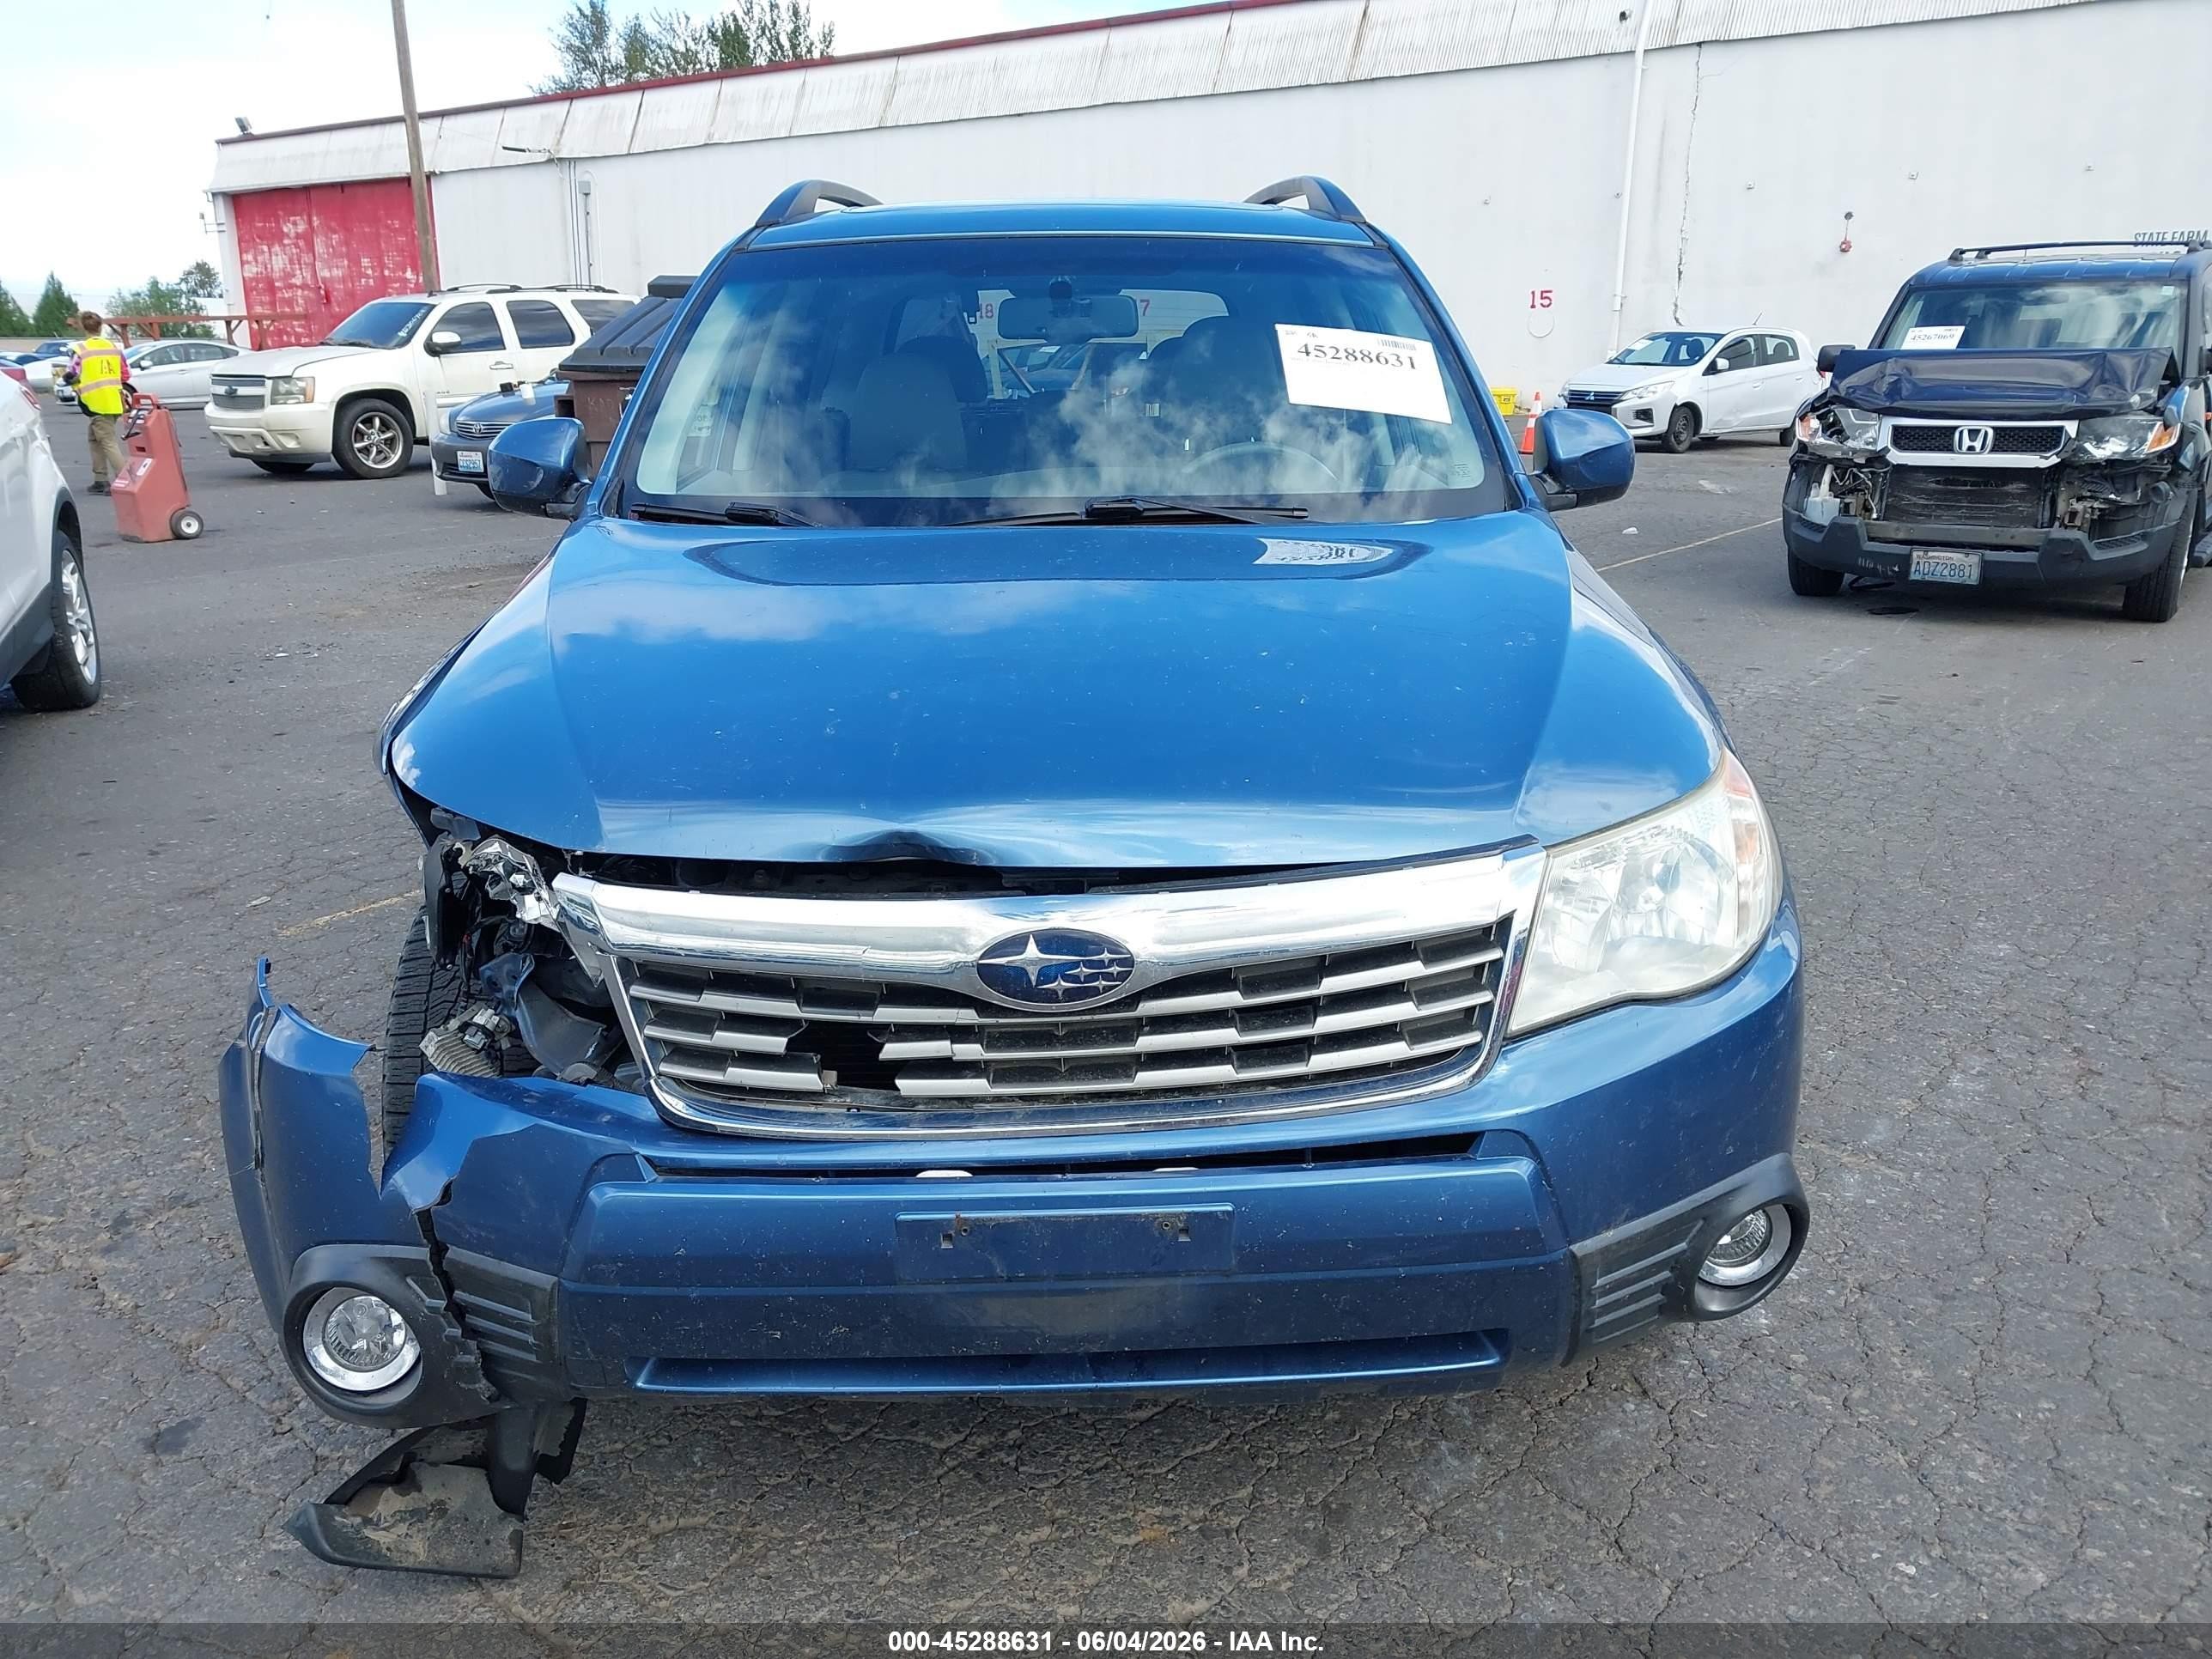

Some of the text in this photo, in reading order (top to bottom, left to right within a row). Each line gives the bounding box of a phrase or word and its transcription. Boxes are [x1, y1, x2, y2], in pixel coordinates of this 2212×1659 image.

[2134, 231, 2168, 247] STATE
[1530, 289, 1553, 309] 15
[1297, 343, 1417, 370] 45288631
[1913, 560, 1973, 579] ADZ2881
